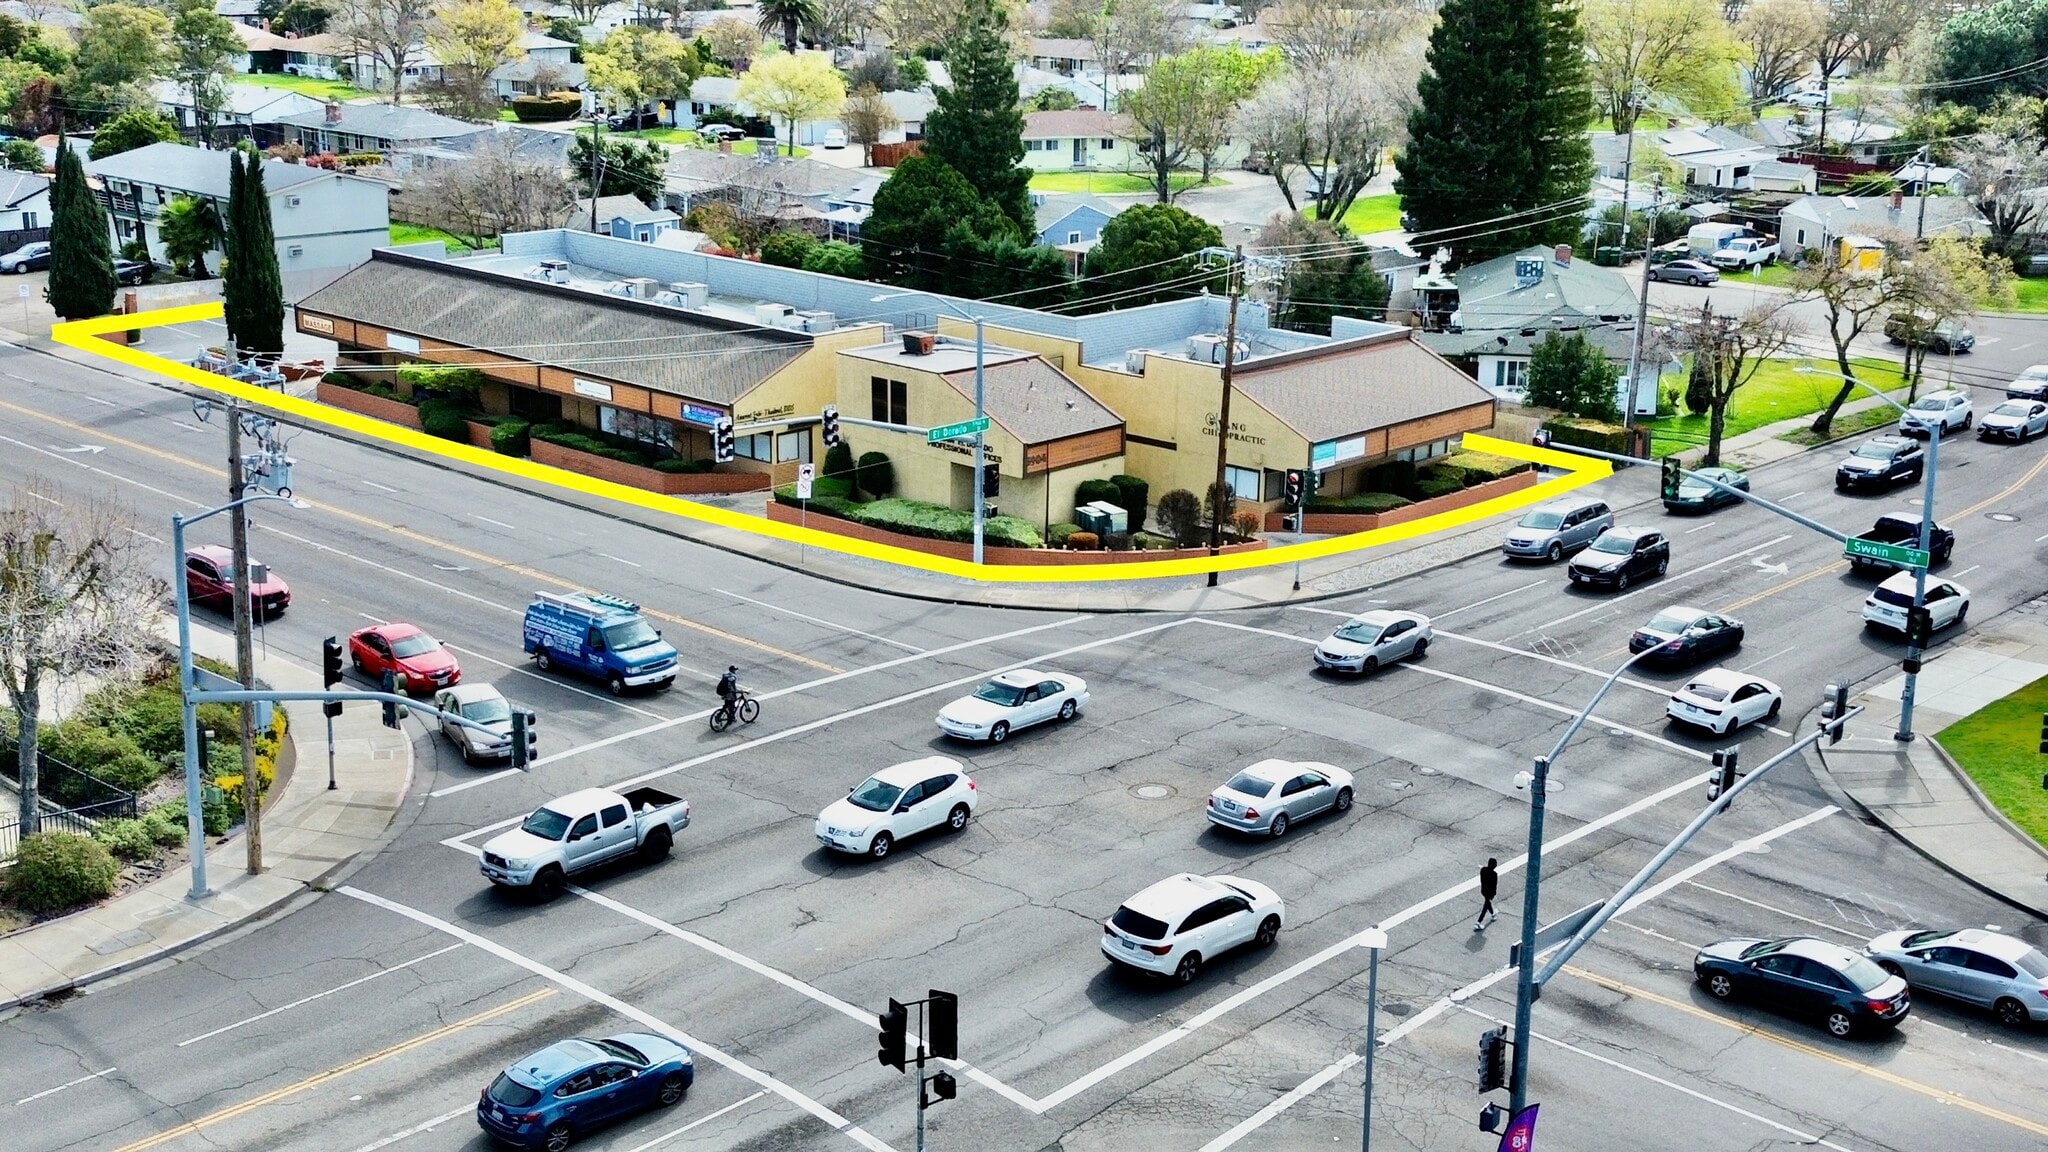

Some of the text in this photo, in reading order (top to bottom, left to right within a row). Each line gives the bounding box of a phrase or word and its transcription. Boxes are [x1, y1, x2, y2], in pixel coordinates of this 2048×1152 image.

[933, 425, 967, 439] El Dorado
[1854, 542, 1889, 558] Swain
